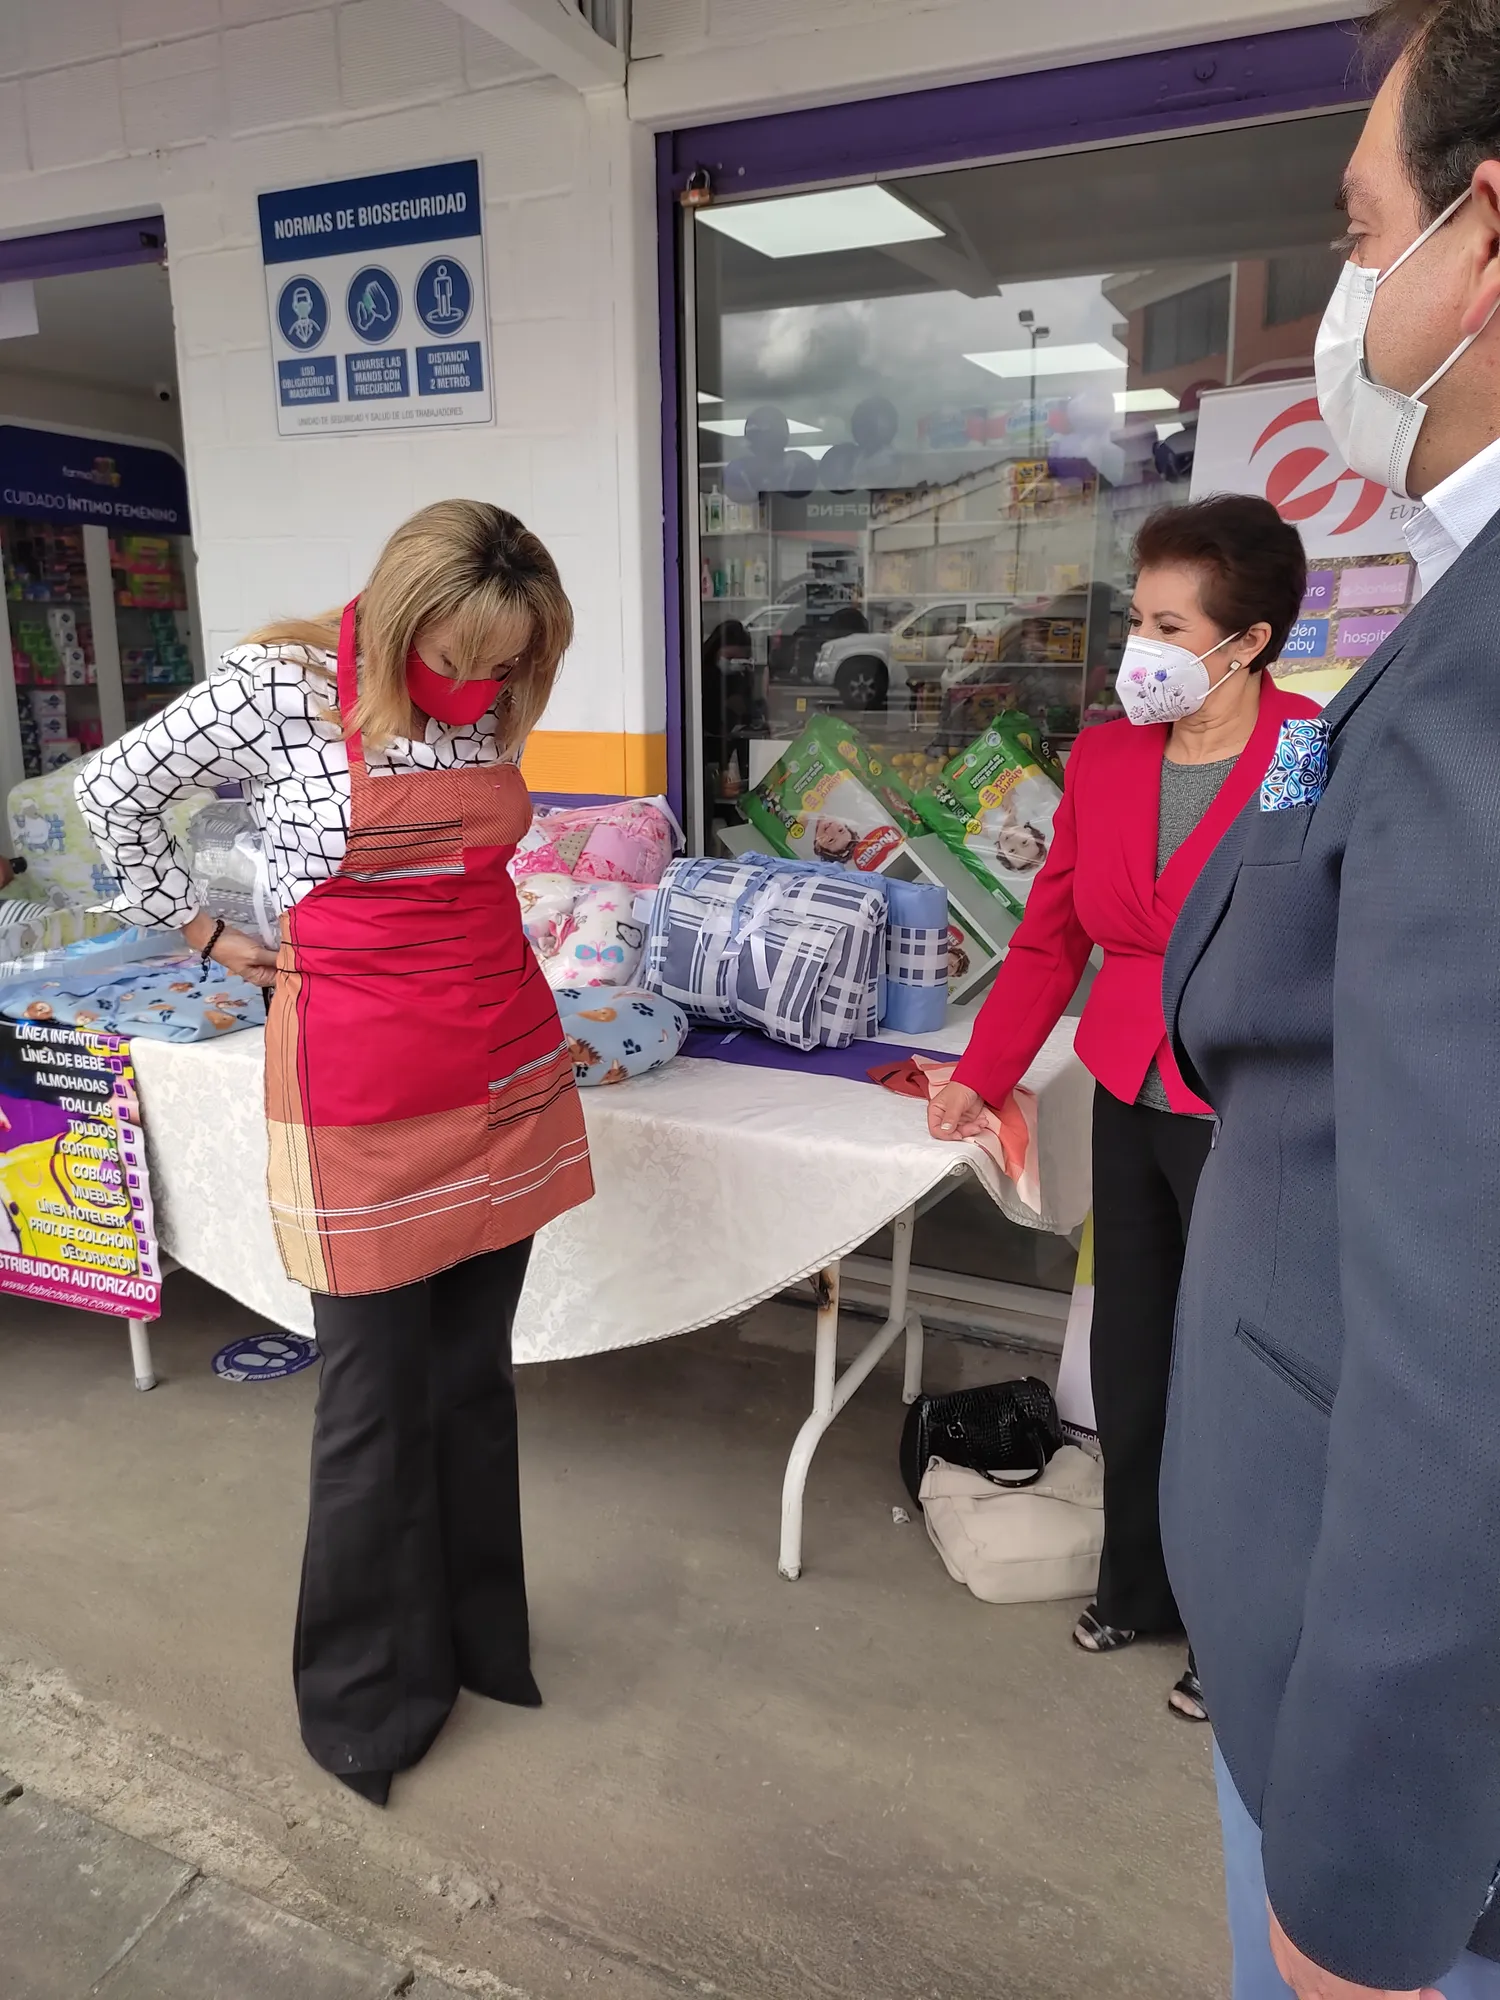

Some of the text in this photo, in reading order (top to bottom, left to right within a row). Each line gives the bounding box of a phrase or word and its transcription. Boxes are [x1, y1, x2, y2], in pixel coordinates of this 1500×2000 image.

[274, 191, 467, 239] NORMAS DE BIOSEGURIDAD
[351, 356, 402, 371] LAVARSE LAS
[428, 350, 470, 364] DISTANCIA
[301, 366, 315, 377] USO
[355, 369, 400, 383] MANOS CON
[281, 375, 335, 389] OBLIGATORIO DE
[355, 381, 402, 395] FRECUENCIA
[430, 376, 470, 390] 2 METROS
[289, 386, 331, 399] MASCARILLA
[4, 488, 177, 522] CUIDADO ÍNTIMO FEMENINO
[1289, 623, 1316, 637] dén
[856, 829, 900, 867] HUGGIES
[16, 1022, 103, 1048] LÍNEA INFANTIL
[21, 1045, 55, 1065] LÍNEA
[56, 1052, 73, 1067] DE
[36, 1071, 109, 1094] ALMOHADAS
[60, 1096, 112, 1117] TOALLAS
[68, 1119, 116, 1139] TOLDOS
[60, 1140, 119, 1161] CORTINAS
[72, 1164, 122, 1184] COBIJAS
[72, 1186, 127, 1206] MUEBLES
[37, 1198, 128, 1229] LÍNEA HOTELERA
[30, 1218, 135, 1250] PROT. DE COLCHÓN
[61, 1246, 137, 1272] DECORACIÓN
[71, 1271, 157, 1303] AUTORIZADO
